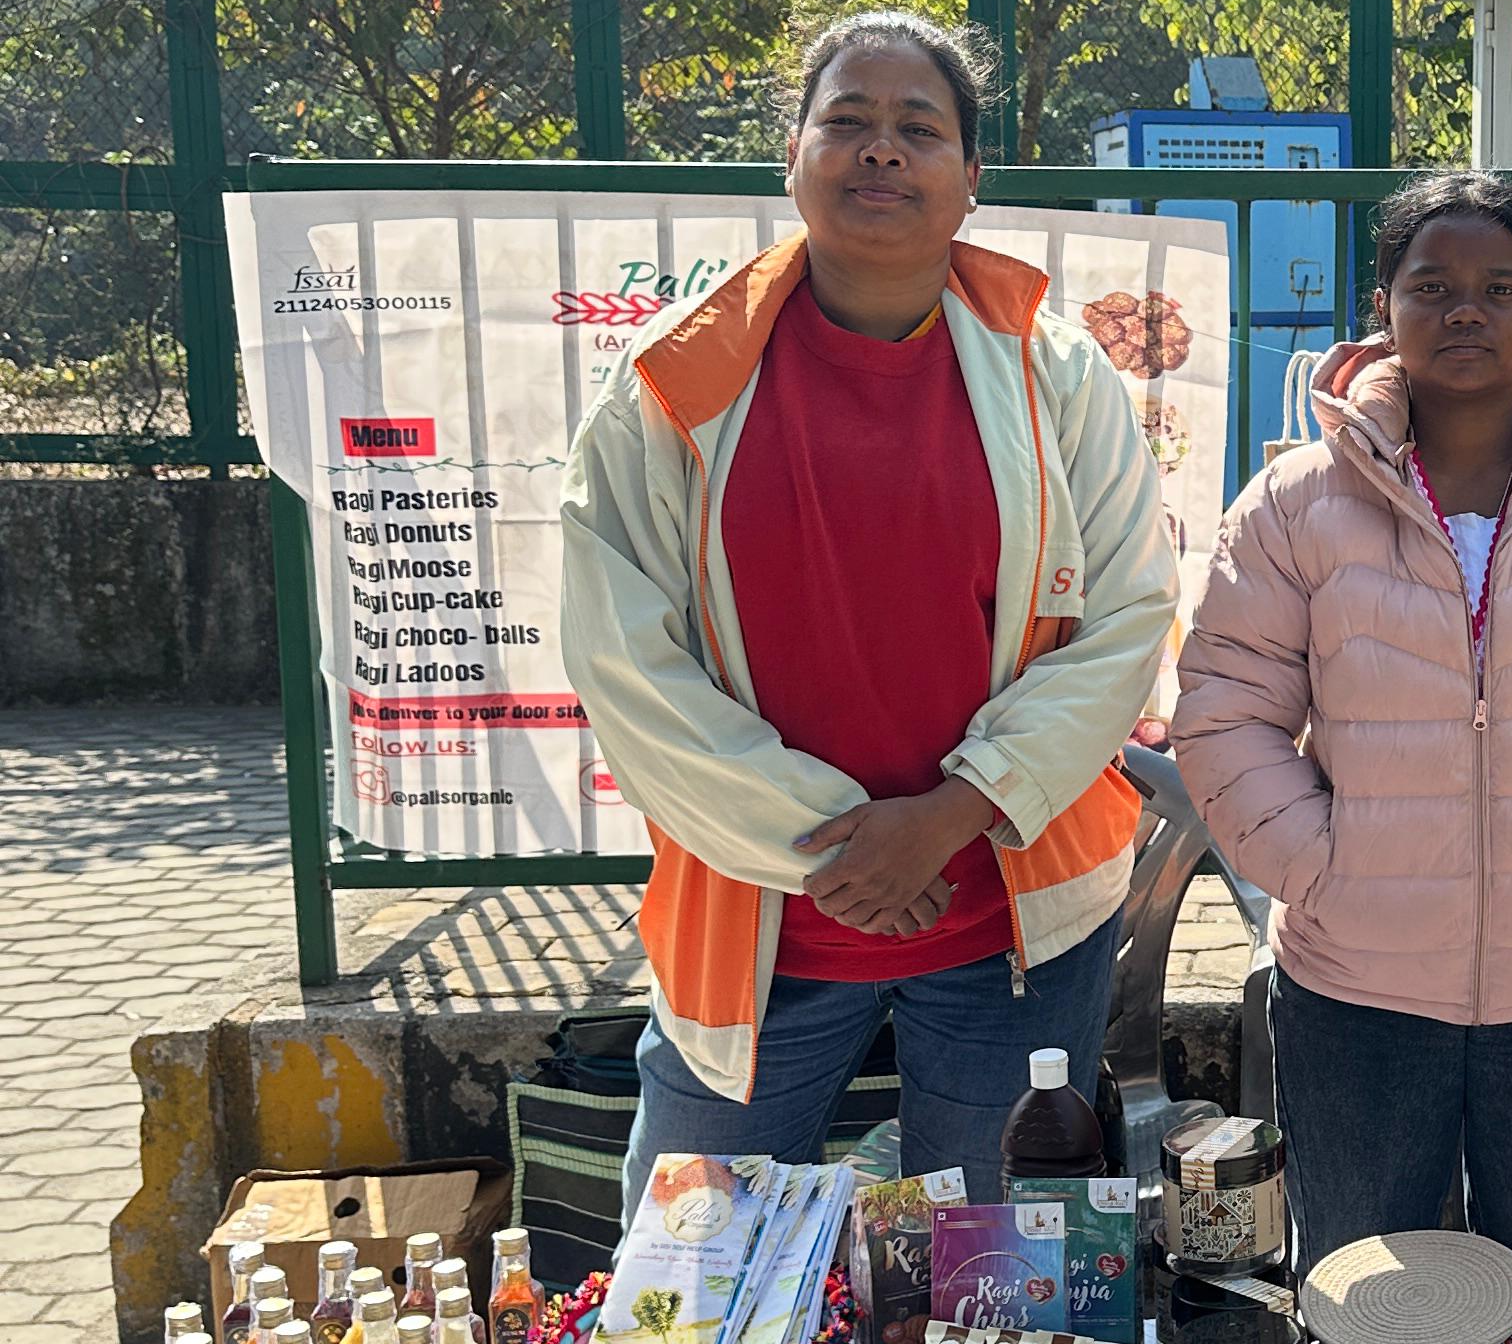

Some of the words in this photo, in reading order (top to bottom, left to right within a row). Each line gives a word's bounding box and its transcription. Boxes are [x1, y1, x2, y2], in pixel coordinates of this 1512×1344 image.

[287, 265, 358, 293] fssai
[619, 258, 728, 298] Pali'
[273, 296, 451, 313] 21124053000115
[351, 425, 419, 447] Menu
[332, 490, 374, 512] Ragi
[381, 487, 499, 510] Pasteries
[344, 521, 380, 546] Ragi
[385, 521, 472, 543] Donuts
[347, 555, 385, 583] Ragi
[388, 559, 472, 579] Moose
[353, 585, 389, 614] Ragi
[391, 589, 504, 613] Cup-cake
[354, 620, 388, 649] Ragi
[485, 624, 540, 645] balls
[355, 655, 389, 685] Ragi
[395, 662, 485, 683] Ladoos
[446, 707, 464, 720] to
[512, 704, 551, 719] door
[437, 740, 477, 753] us:
[391, 789, 513, 807] @palisorganic
[884, 1236, 932, 1273] Ra
[1069, 1253, 1088, 1277] gi
[977, 1275, 1022, 1305] Ragi
[1069, 1276, 1115, 1311] ujia
[954, 1305, 1035, 1330] Chips
